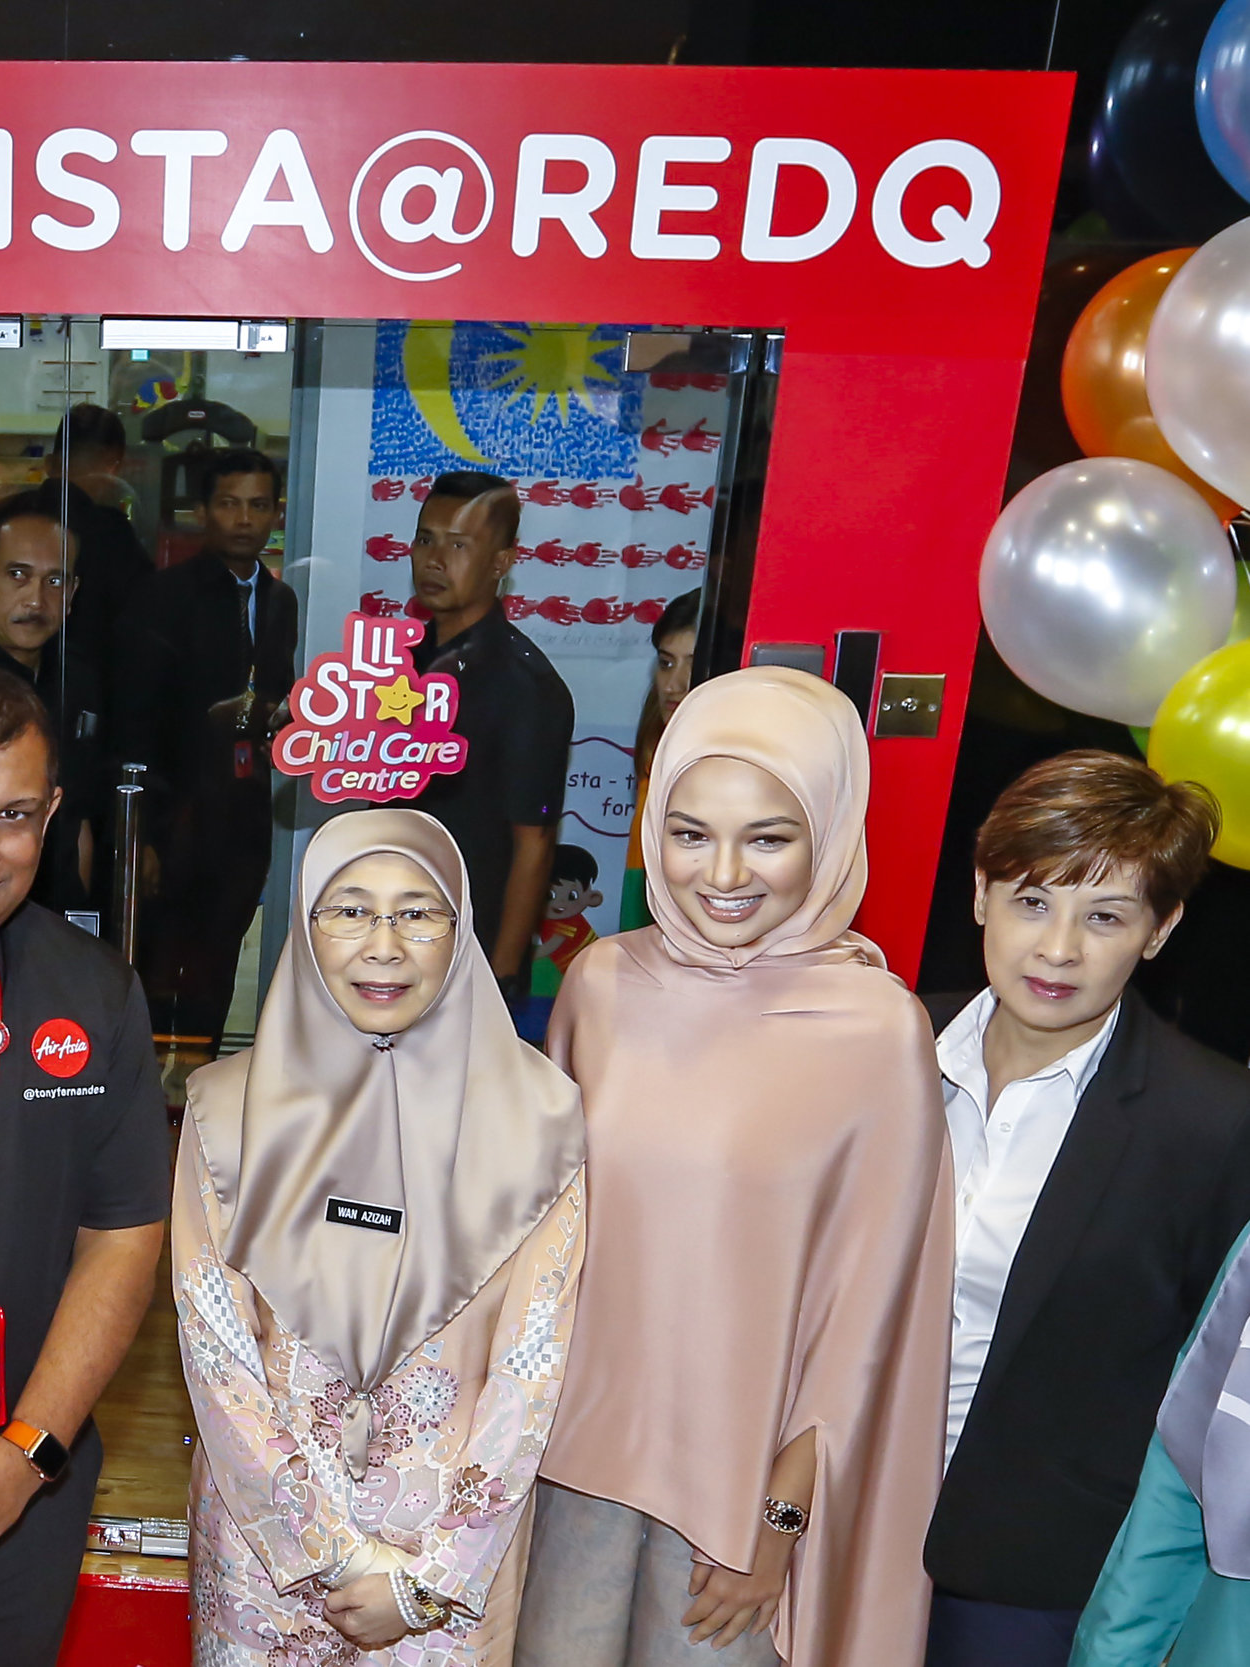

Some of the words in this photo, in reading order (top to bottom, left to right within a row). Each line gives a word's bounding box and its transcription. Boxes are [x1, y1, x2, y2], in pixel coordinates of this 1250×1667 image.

[282, 730, 375, 766] Child
[379, 731, 460, 766] Care
[321, 767, 421, 794] Centre
[567, 771, 601, 788] sta
[602, 796, 635, 817] for
[23, 1084, 106, 1101] @tonyfernandes
[338, 1206, 358, 1220] WAN
[361, 1210, 392, 1226] AZIZAH
